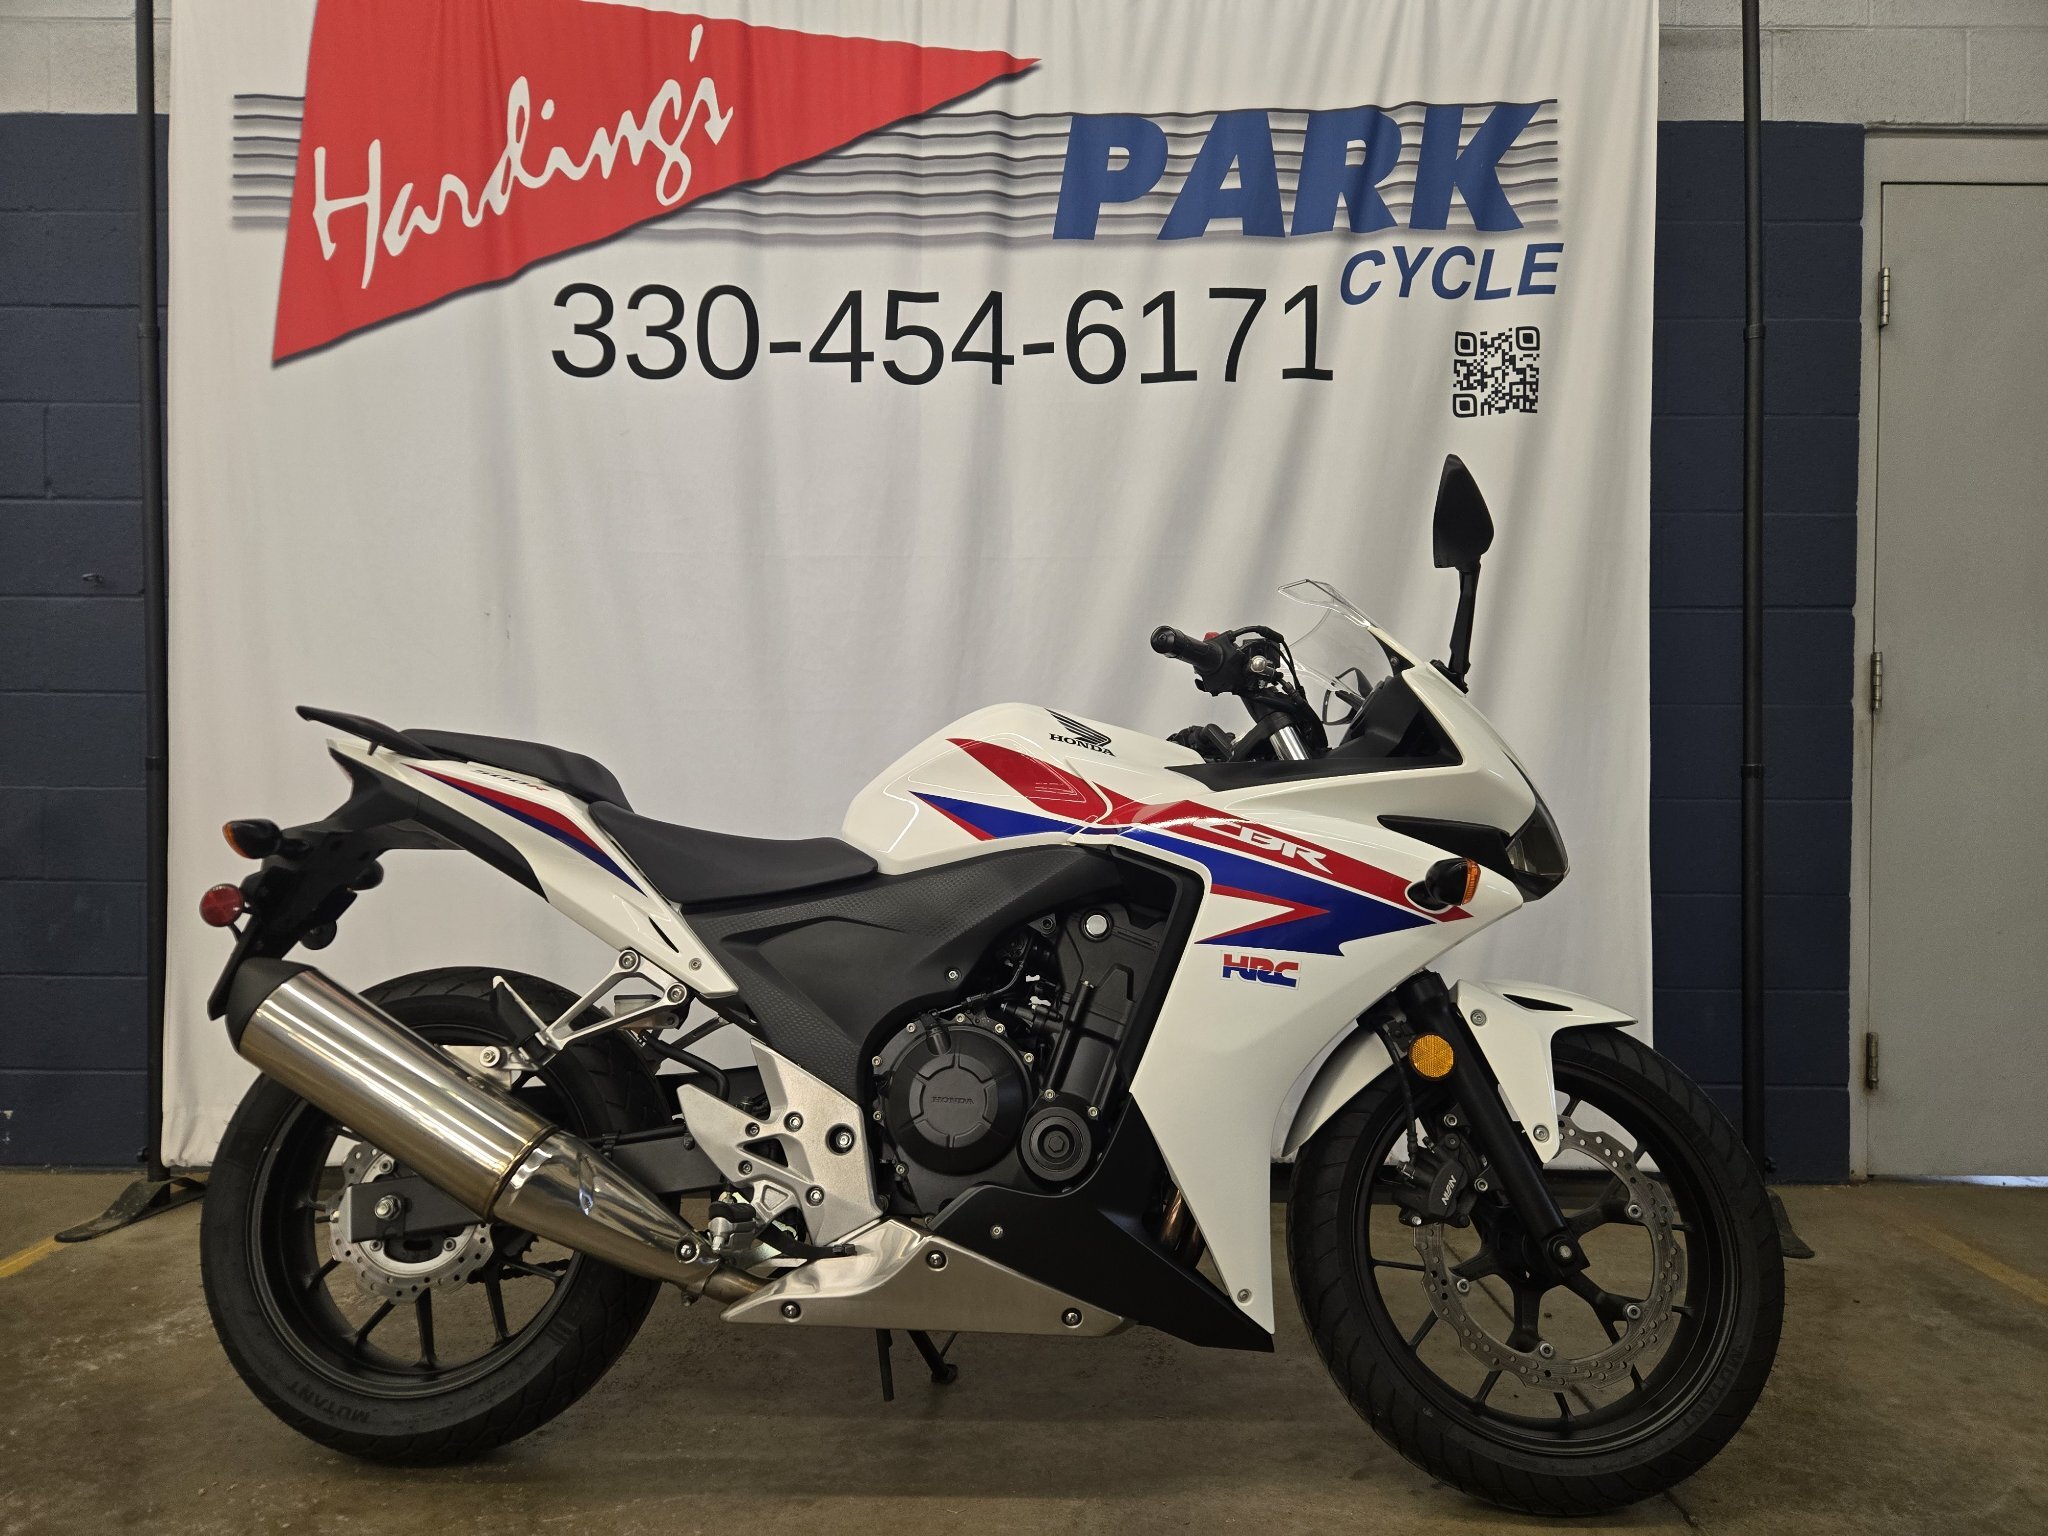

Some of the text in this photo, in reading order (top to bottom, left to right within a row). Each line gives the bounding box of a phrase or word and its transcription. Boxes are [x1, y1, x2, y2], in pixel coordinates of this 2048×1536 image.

[313, 24, 733, 289] Harding's
[1053, 102, 1543, 241] PARK
[1339, 242, 1564, 306] CYCLE
[551, 282, 1335, 386] 330-454-6171
[1048, 732, 1116, 758] HONDA
[1192, 816, 1334, 876] CBR
[1222, 953, 1299, 988] HRC
[931, 1095, 975, 1105] HONDA
